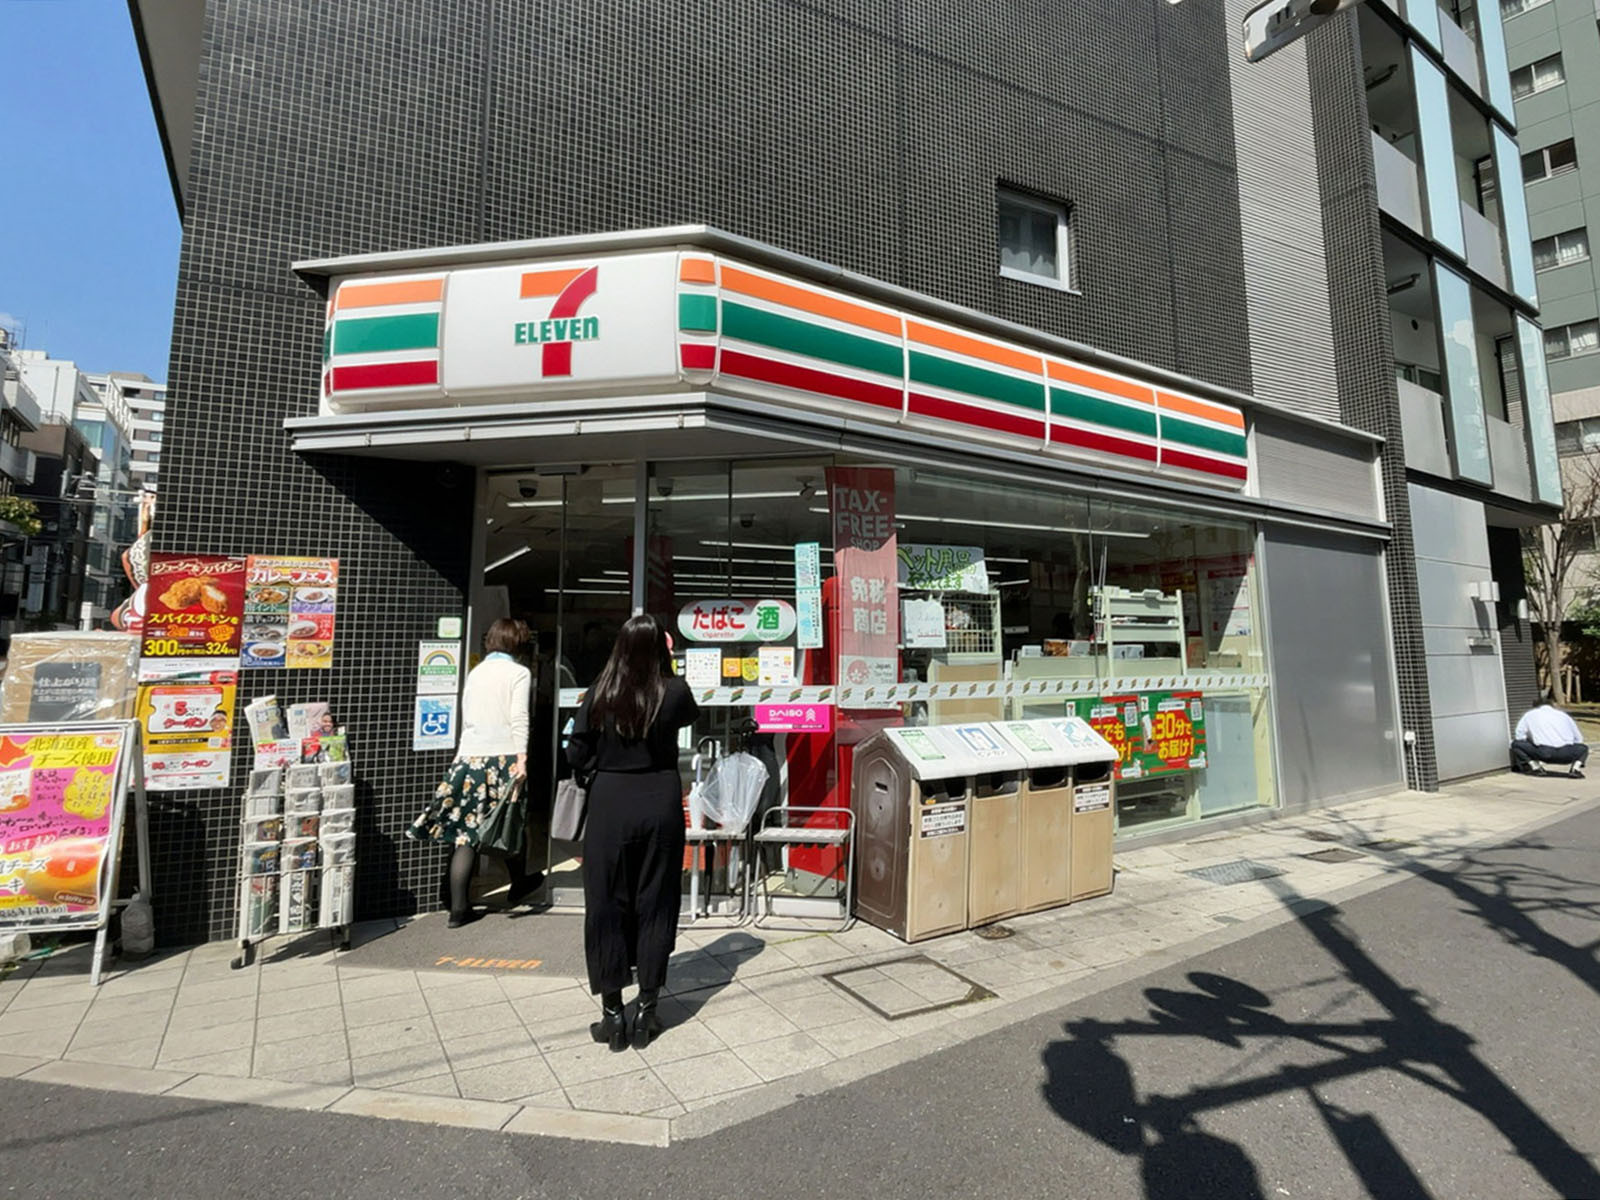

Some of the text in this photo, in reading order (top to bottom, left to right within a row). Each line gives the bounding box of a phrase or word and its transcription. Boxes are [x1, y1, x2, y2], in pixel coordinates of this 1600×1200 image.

[835, 488, 887, 513] TAX-
[836, 512, 889, 538] FREE
[249, 569, 334, 584] カレーフェス
[850, 576, 887, 605] 免税
[692, 606, 745, 631] たばこ
[756, 606, 780, 630] 酒
[852, 607, 887, 636] 商店
[769, 709, 803, 717] DAISO
[30, 736, 90, 751] 北海道産
[38, 751, 114, 766] チーズ使用
